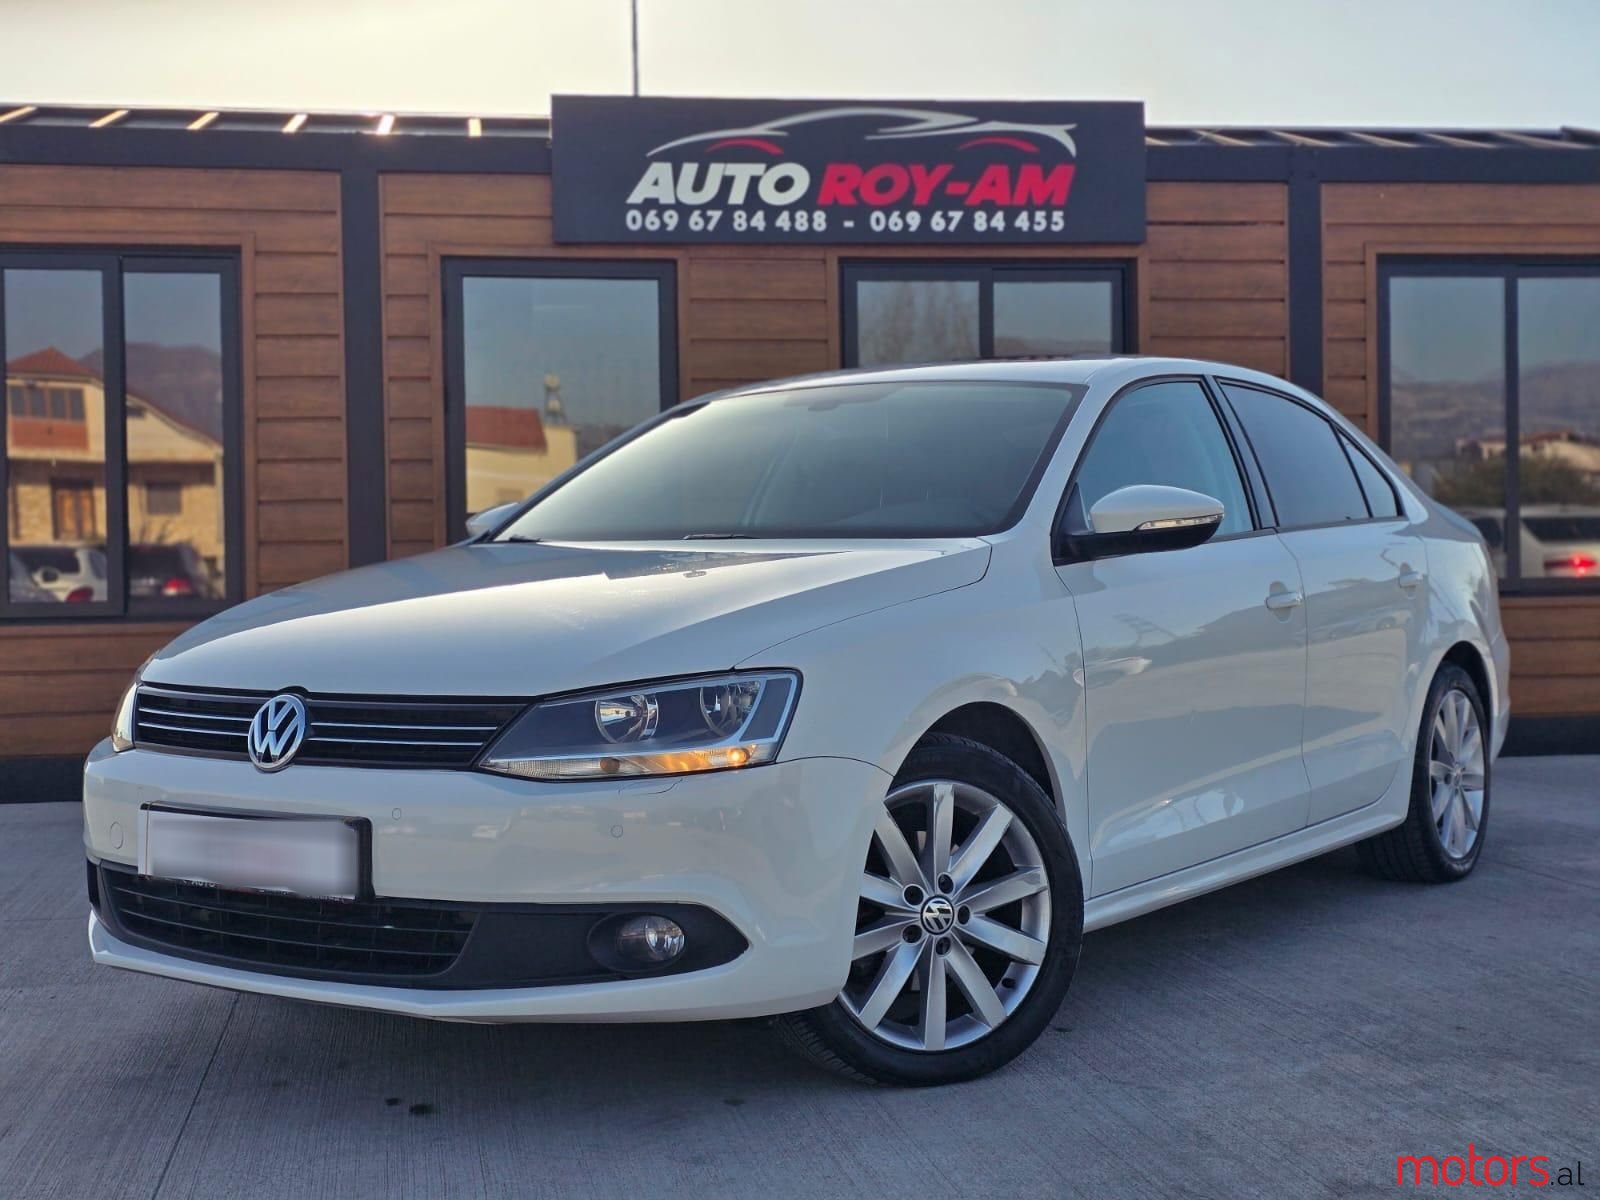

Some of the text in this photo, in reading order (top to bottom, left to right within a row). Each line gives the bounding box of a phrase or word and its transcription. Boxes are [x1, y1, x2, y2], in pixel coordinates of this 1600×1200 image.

[626, 162, 1072, 206] AUTO ROY-AM
[626, 209, 679, 231] 069
[688, 210, 723, 231] 67
[733, 210, 766, 231] 84
[775, 210, 827, 231] 488
[870, 210, 921, 232] 069
[930, 210, 964, 232] 67
[973, 210, 1006, 232] 84
[1014, 210, 1065, 232] 455
